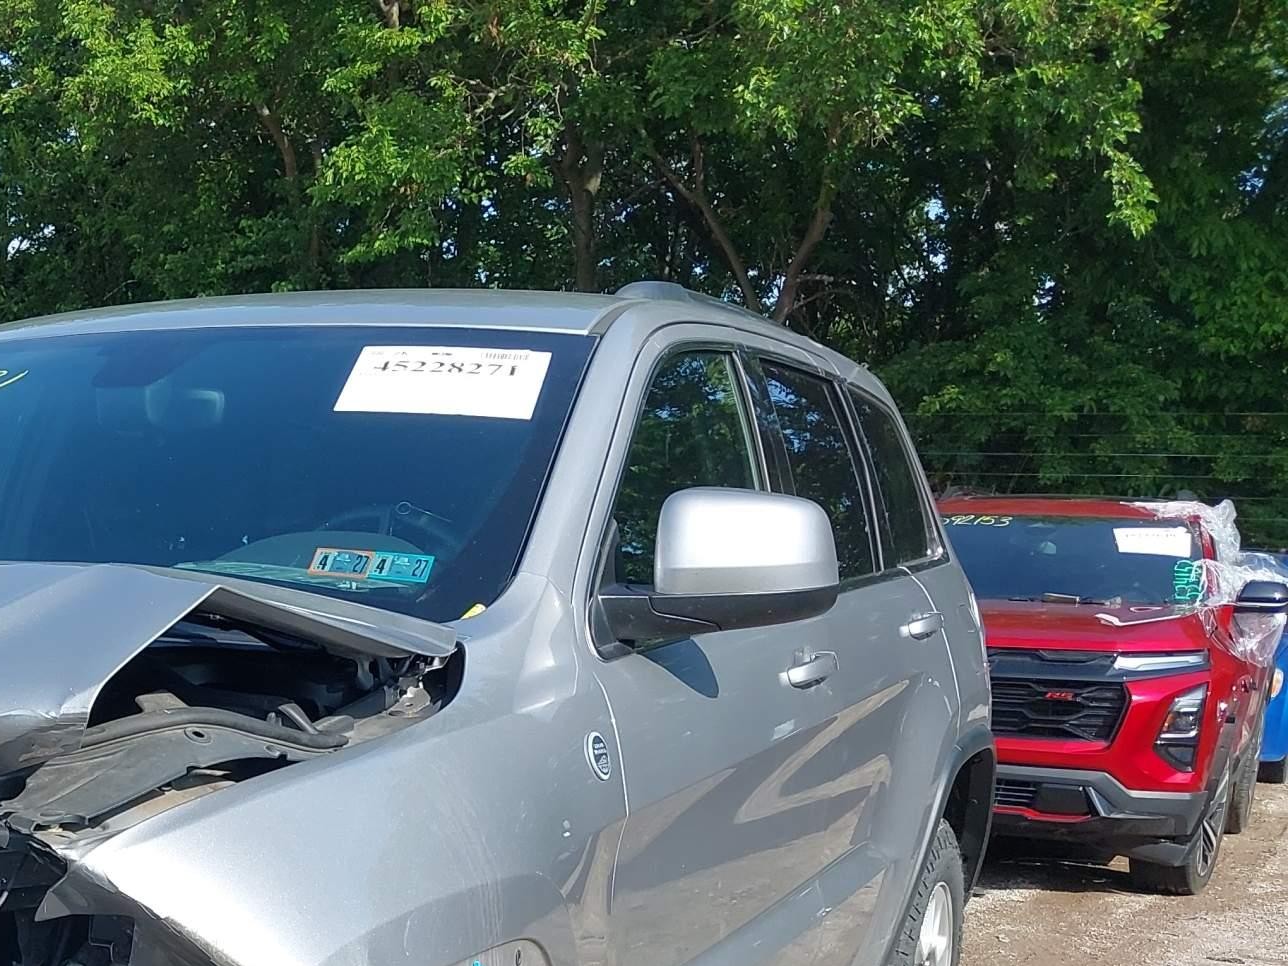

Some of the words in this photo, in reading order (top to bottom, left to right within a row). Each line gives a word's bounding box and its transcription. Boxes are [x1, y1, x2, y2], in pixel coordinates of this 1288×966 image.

[373, 360, 518, 376] 45228271
[318, 553, 329, 570] 4
[352, 554, 370, 574] 27
[375, 558, 387, 574] 4
[411, 558, 428, 577] 27
